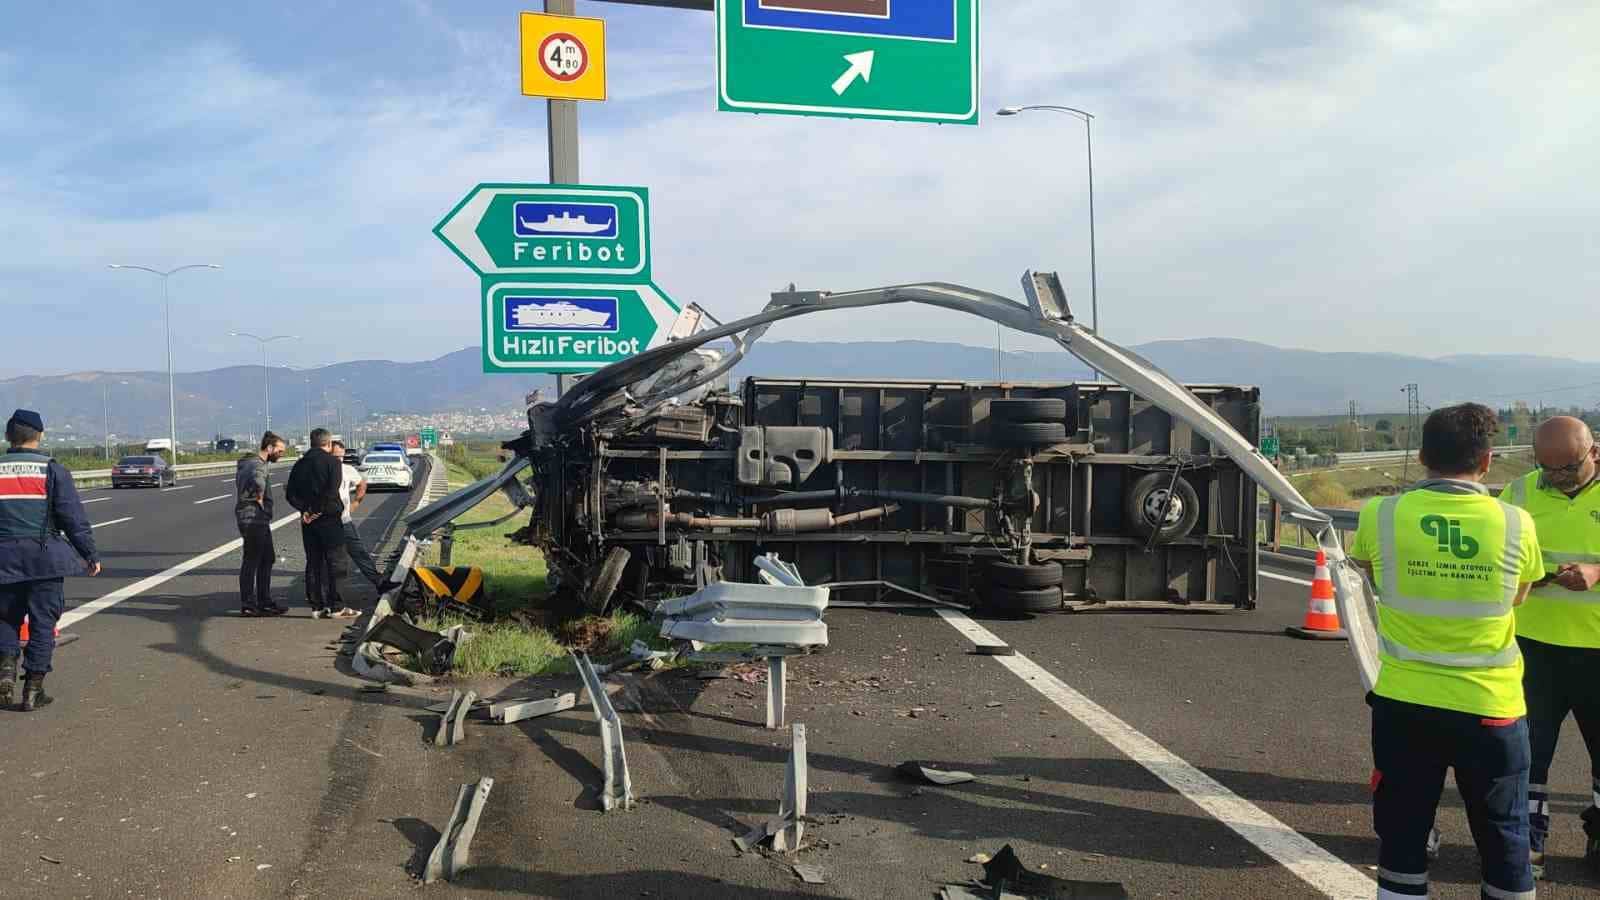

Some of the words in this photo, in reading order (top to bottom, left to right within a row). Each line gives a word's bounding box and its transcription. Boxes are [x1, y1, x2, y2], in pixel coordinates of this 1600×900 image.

[550, 46, 562, 68] 4
[514, 241, 625, 261] Feribot
[503, 335, 554, 355] Hızlı
[558, 335, 640, 355] Feribot
